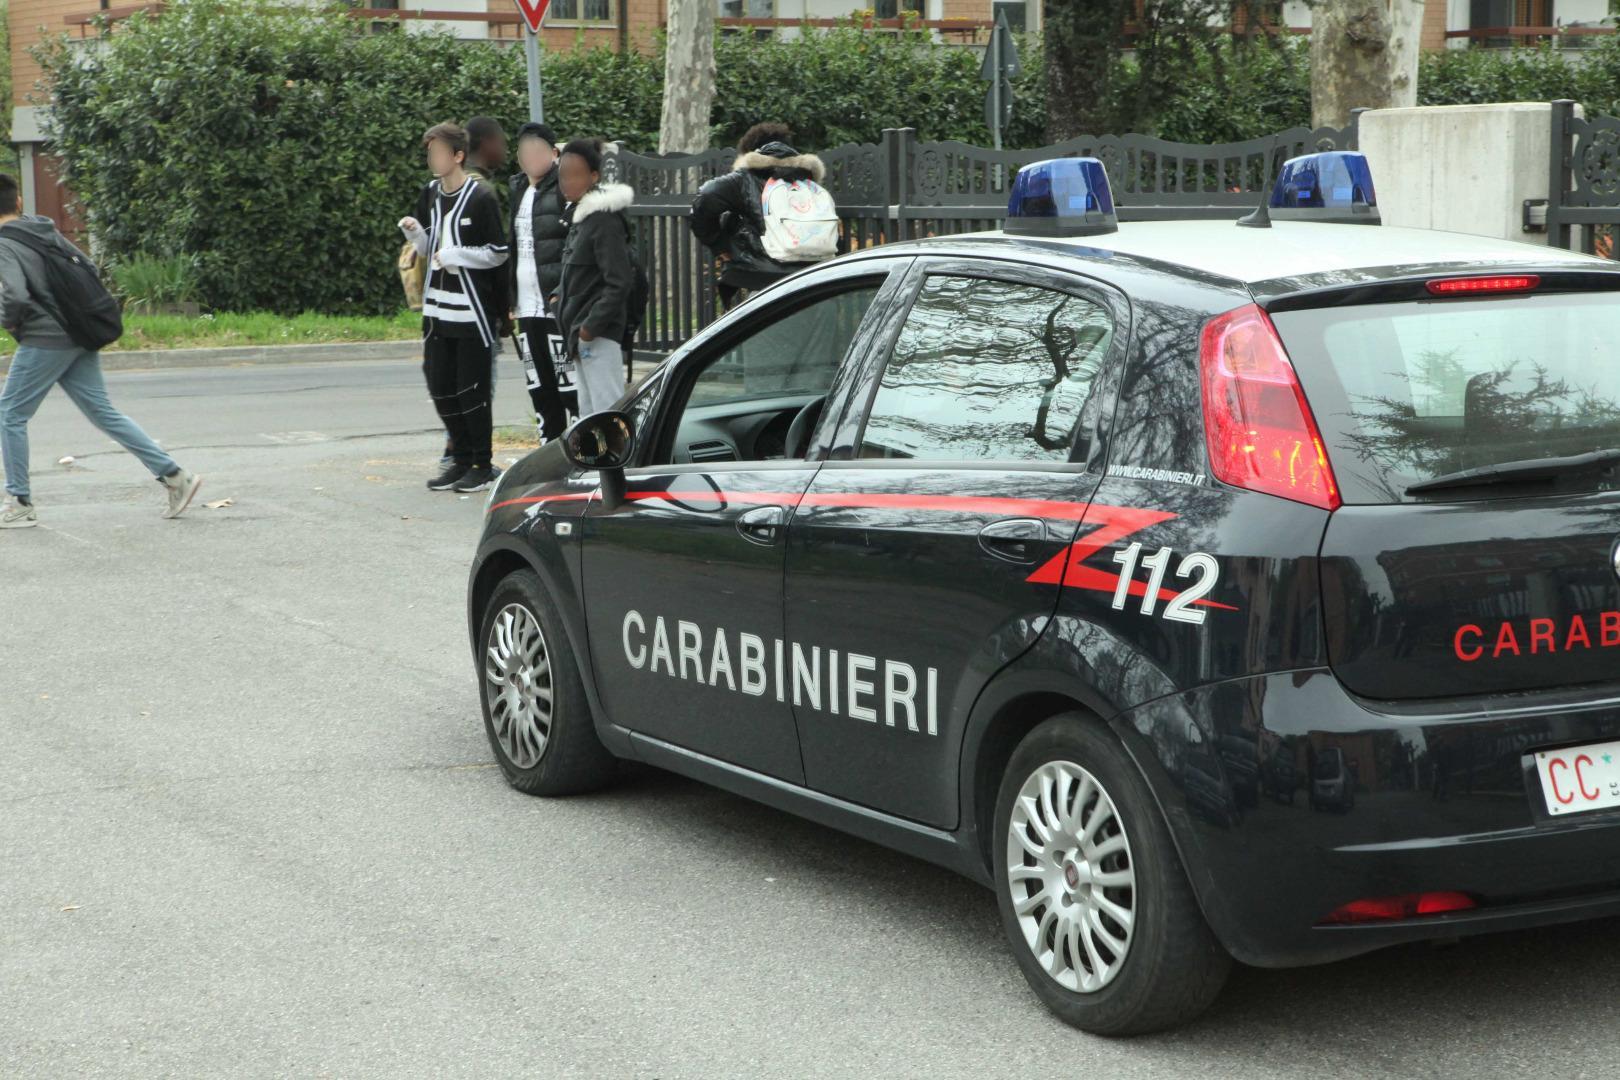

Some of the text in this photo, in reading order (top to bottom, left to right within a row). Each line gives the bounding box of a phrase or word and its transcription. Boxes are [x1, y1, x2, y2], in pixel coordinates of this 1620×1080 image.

[1108, 464, 1206, 486] WWW.CARABINIERI.IT
[1112, 542, 1219, 625] 112
[1454, 611, 1620, 661] CARAB
[622, 609, 938, 736] CARABINIERI
[1548, 754, 1600, 805] CC
